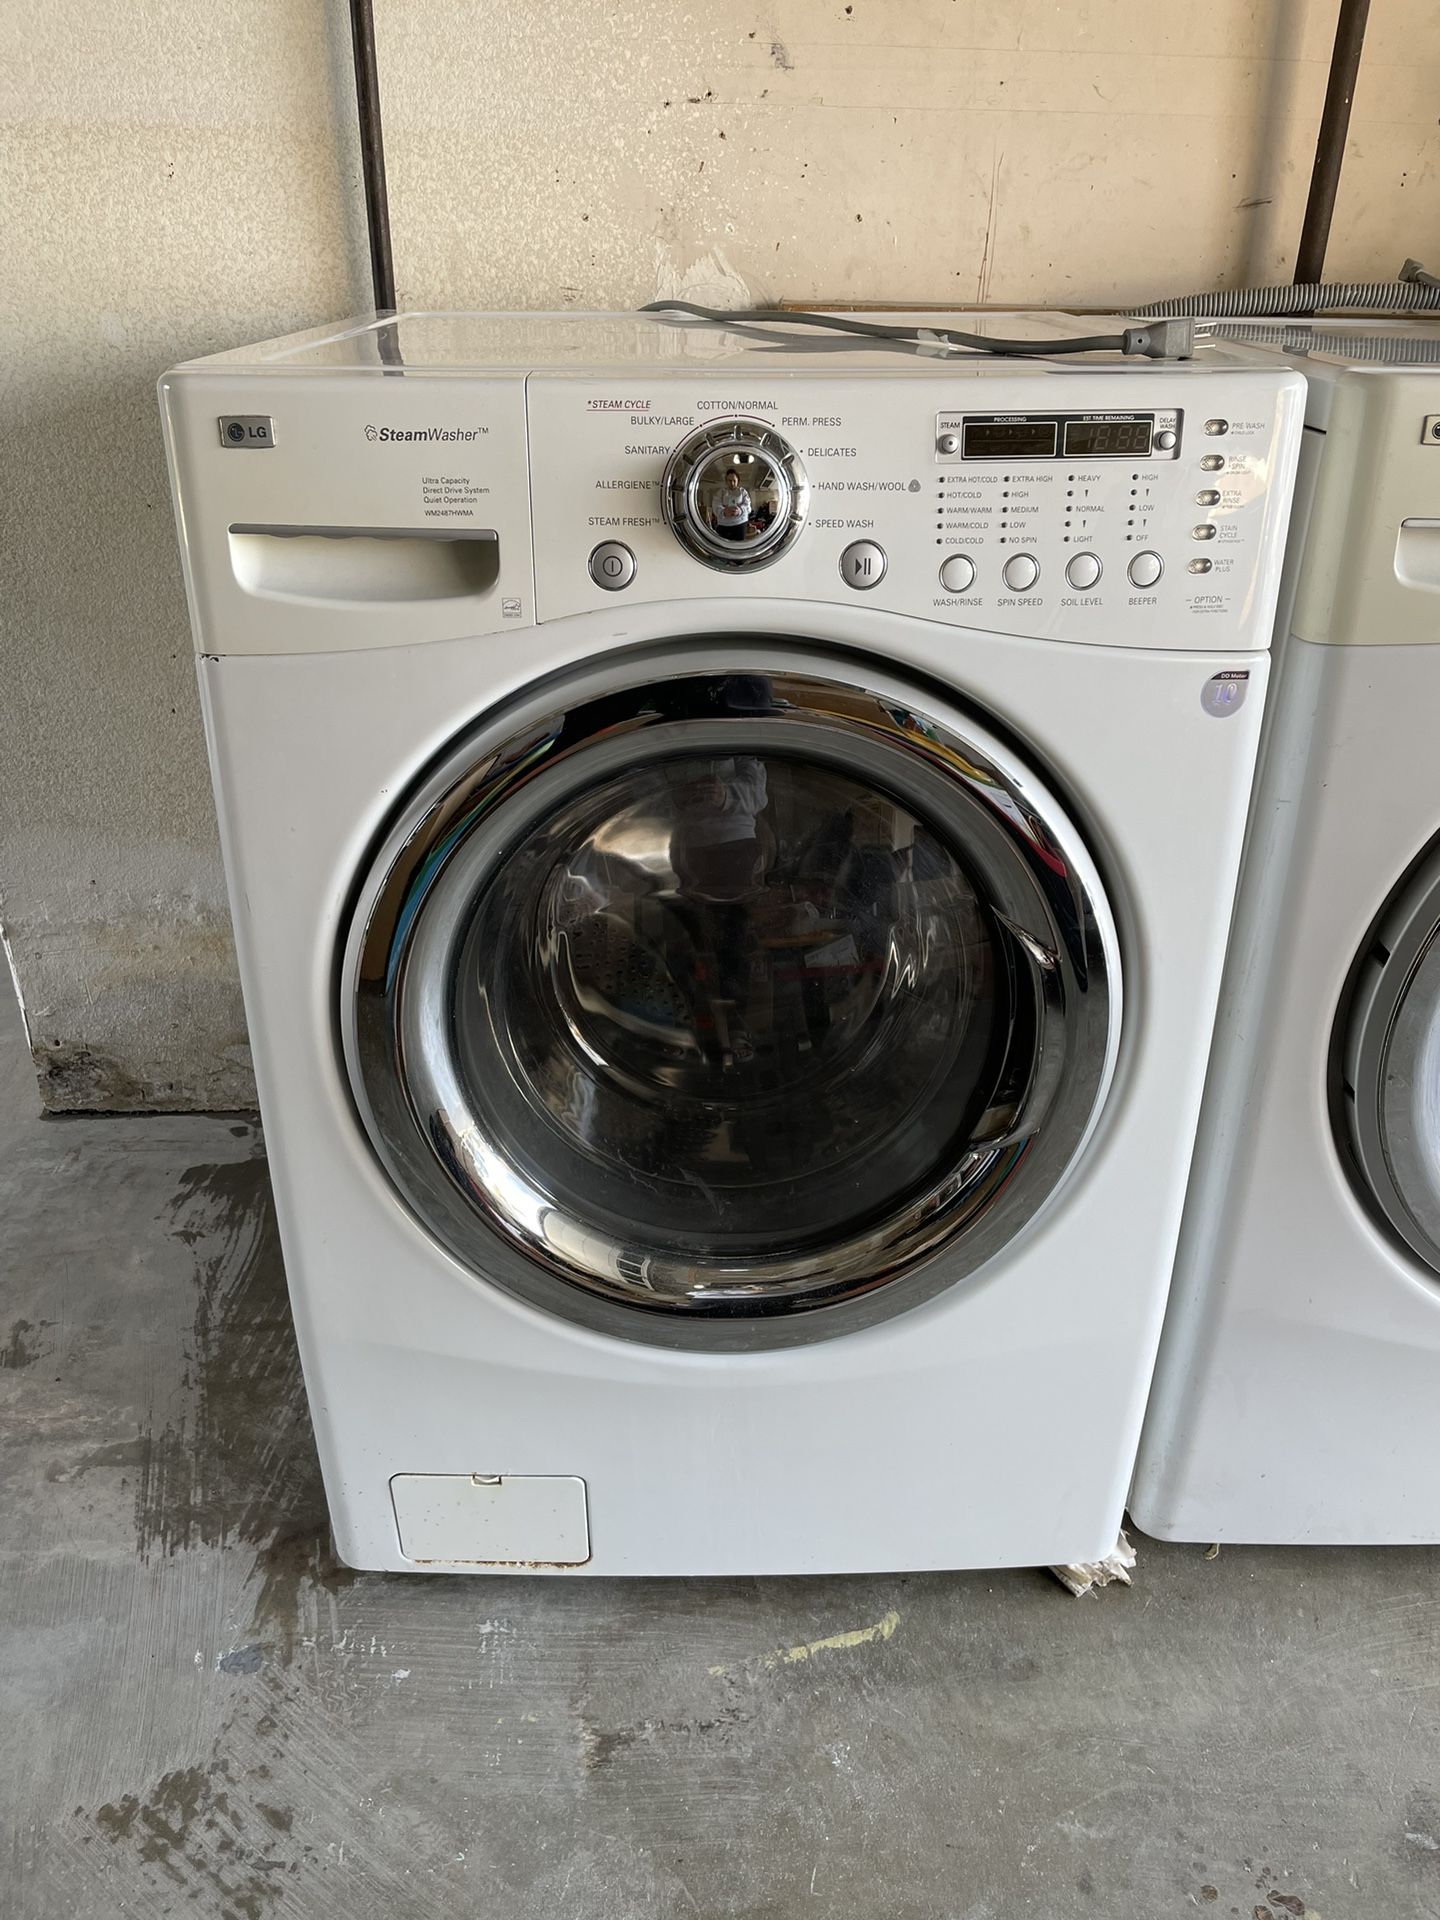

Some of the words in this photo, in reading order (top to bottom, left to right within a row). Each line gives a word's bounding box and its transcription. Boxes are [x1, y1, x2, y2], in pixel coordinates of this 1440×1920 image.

[624, 400, 651, 409] CYCLE
[697, 400, 778, 410] COTTON/NORMAL
[630, 416, 695, 426] BULKY/LARGE
[782, 417, 810, 426] PERM.
[813, 417, 842, 426] PRESS
[249, 426, 267, 438] LG
[624, 446, 670, 455] SANITARY
[808, 448, 857, 457] DELICATES
[440, 477, 470, 485] Capacity
[464, 487, 490, 495] System
[818, 482, 844, 491] HAND
[846, 482, 906, 491] WASH/WOOL
[443, 496, 477, 504] Operation
[588, 517, 620, 526] STEAM
[815, 519, 844, 528] SPEED
[846, 519, 874, 528] WASH
[933, 598, 983, 606] WASH/RINSE
[997, 598, 1017, 606] SPIN
[1018, 598, 1043, 606] SPEED
[1060, 598, 1078, 606] SOIL
[1080, 598, 1103, 606] LEVEL
[1128, 597, 1157, 605] BEEPER
[1194, 596, 1222, 604] OPTION
[1212, 683, 1237, 705] 10
